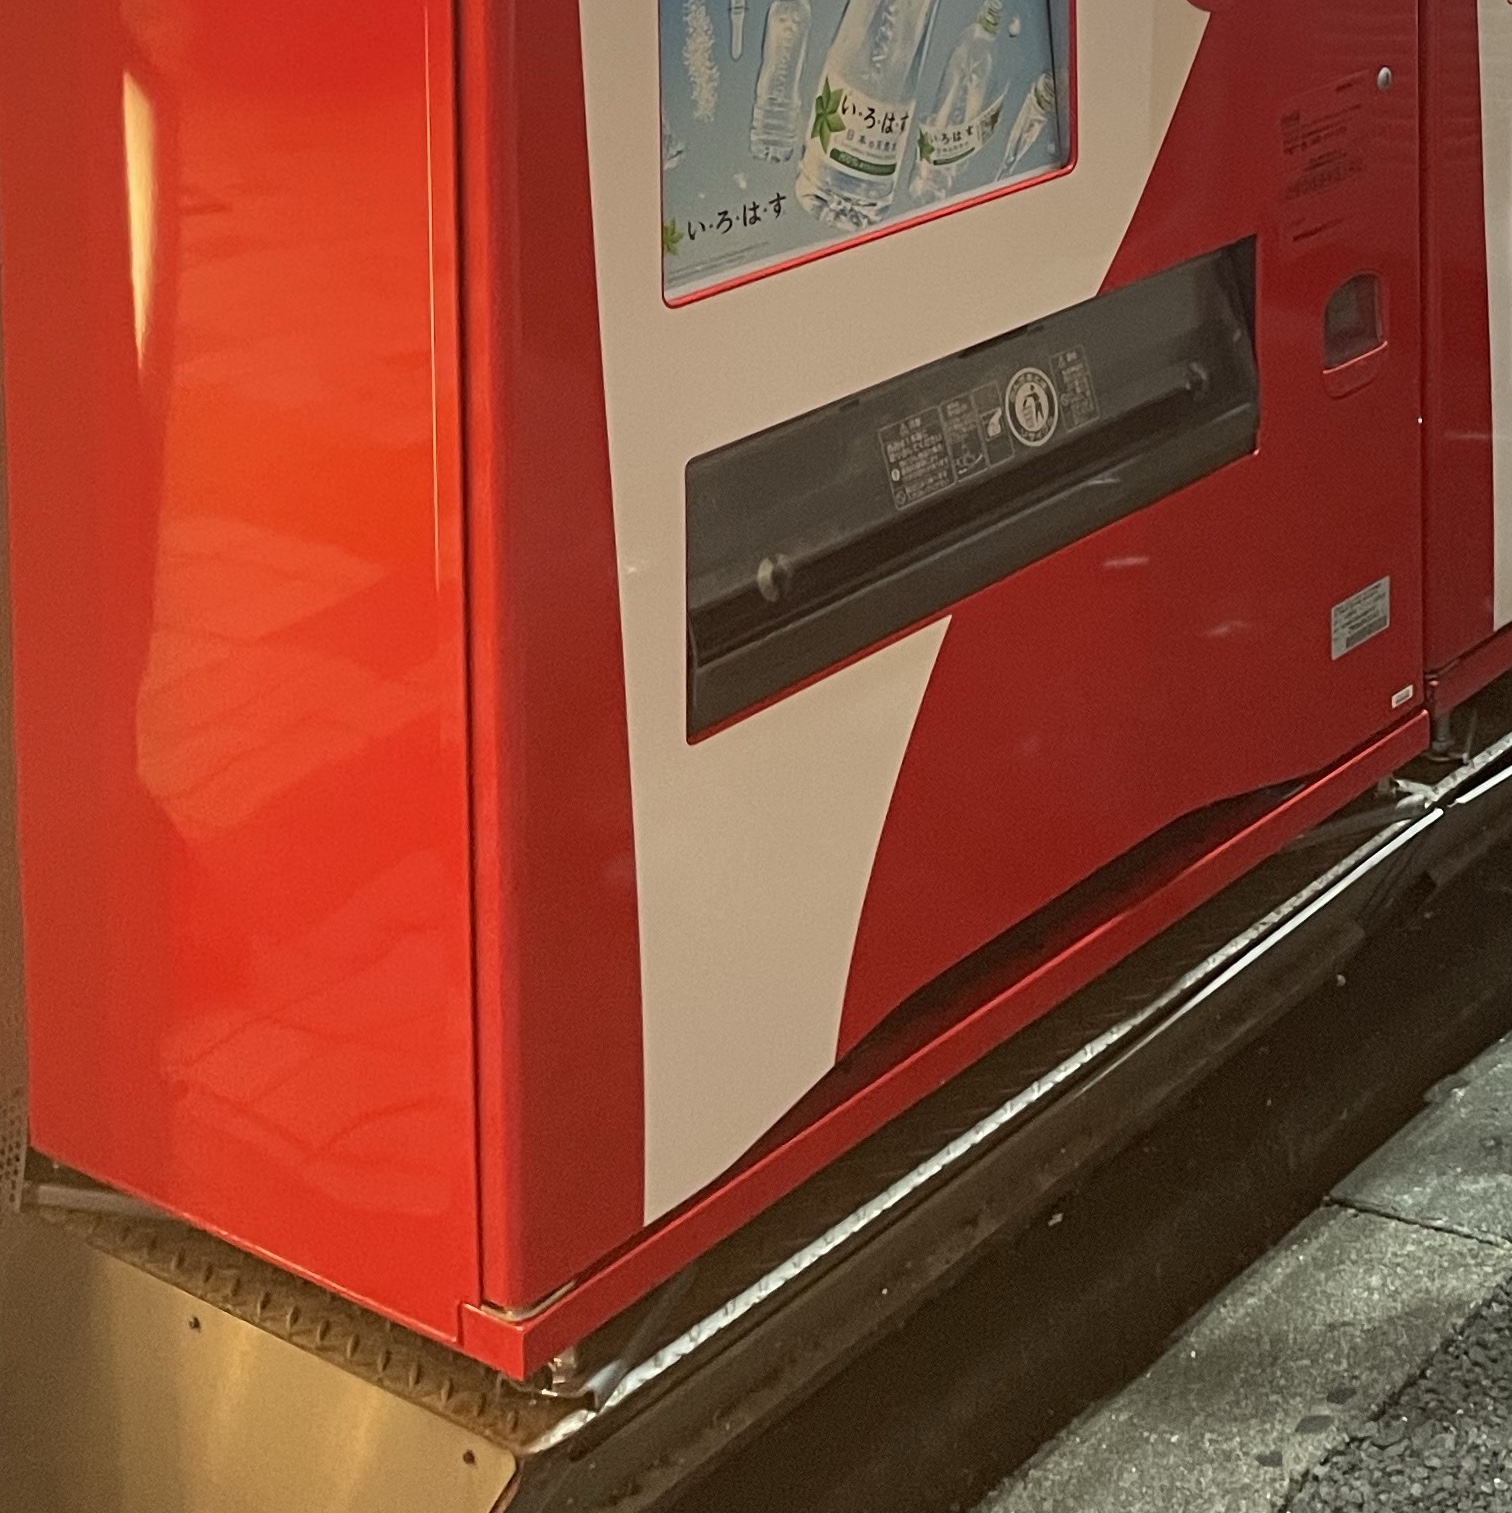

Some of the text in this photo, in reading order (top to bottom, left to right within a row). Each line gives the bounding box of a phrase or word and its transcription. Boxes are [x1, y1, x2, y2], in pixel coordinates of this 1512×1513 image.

[686, 192, 789, 242] い・ろ・は・す
